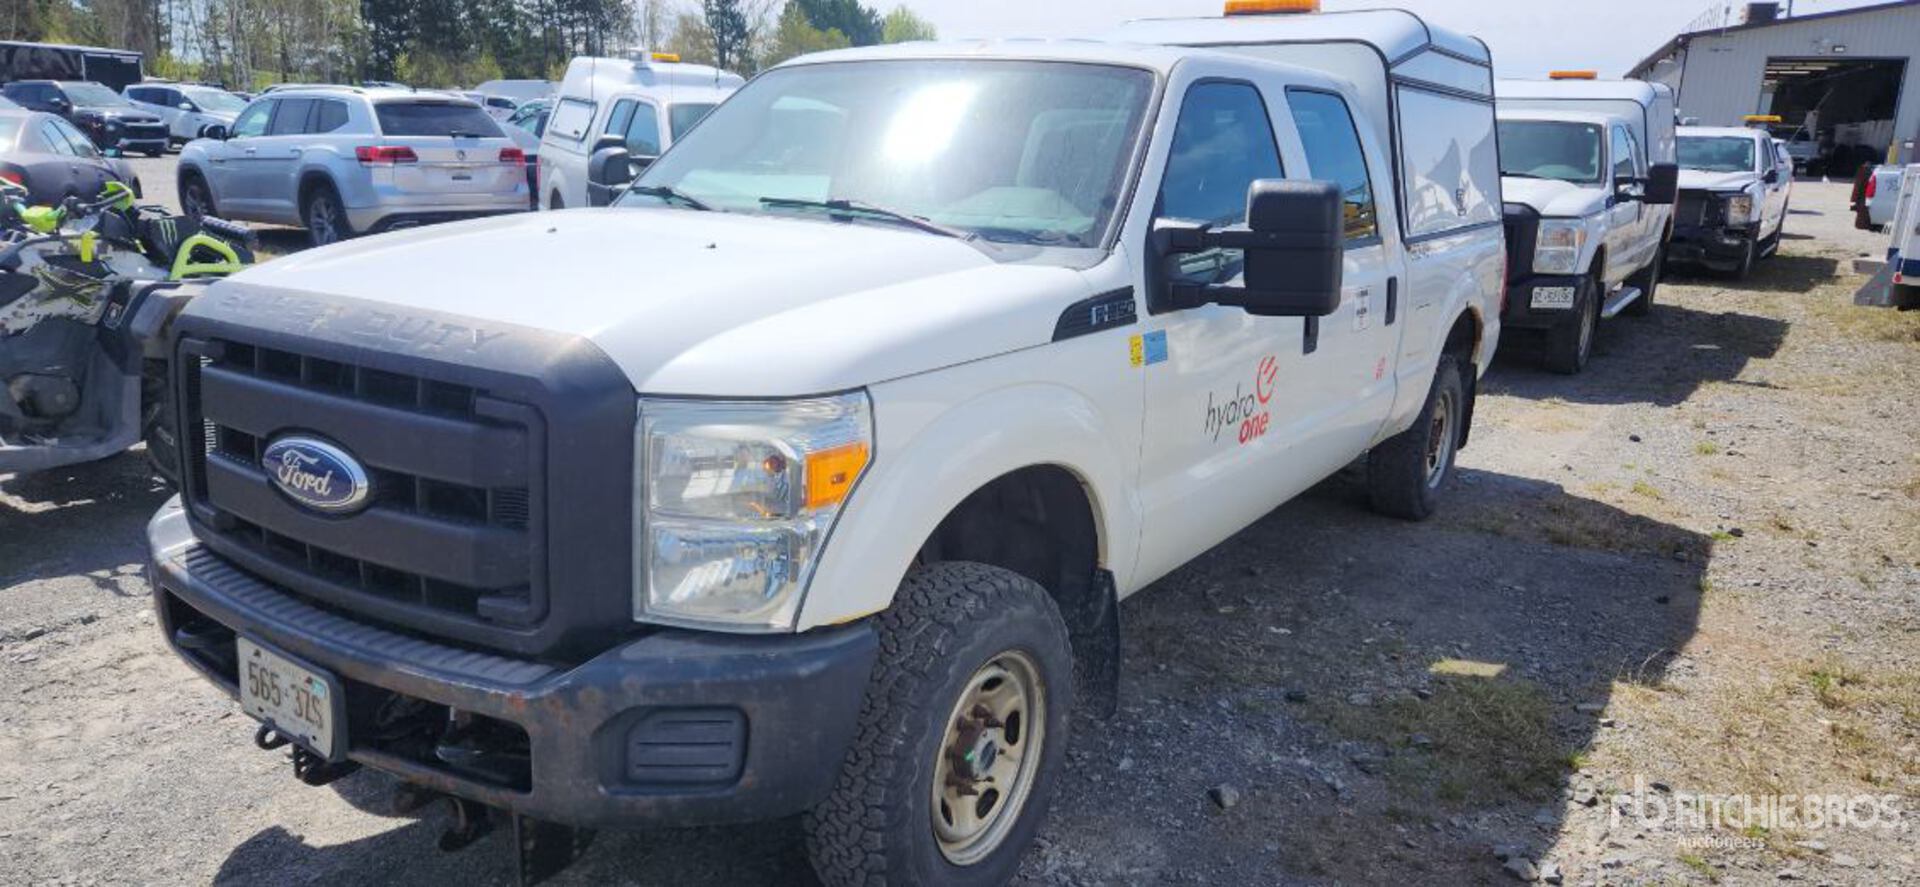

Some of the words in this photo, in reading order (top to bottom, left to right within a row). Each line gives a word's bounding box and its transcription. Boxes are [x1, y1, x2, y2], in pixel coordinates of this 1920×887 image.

[353, 309, 508, 354] DUTY
[1204, 382, 1255, 443] hydro
[1239, 412, 1269, 444] one
[278, 449, 333, 496] Ford
